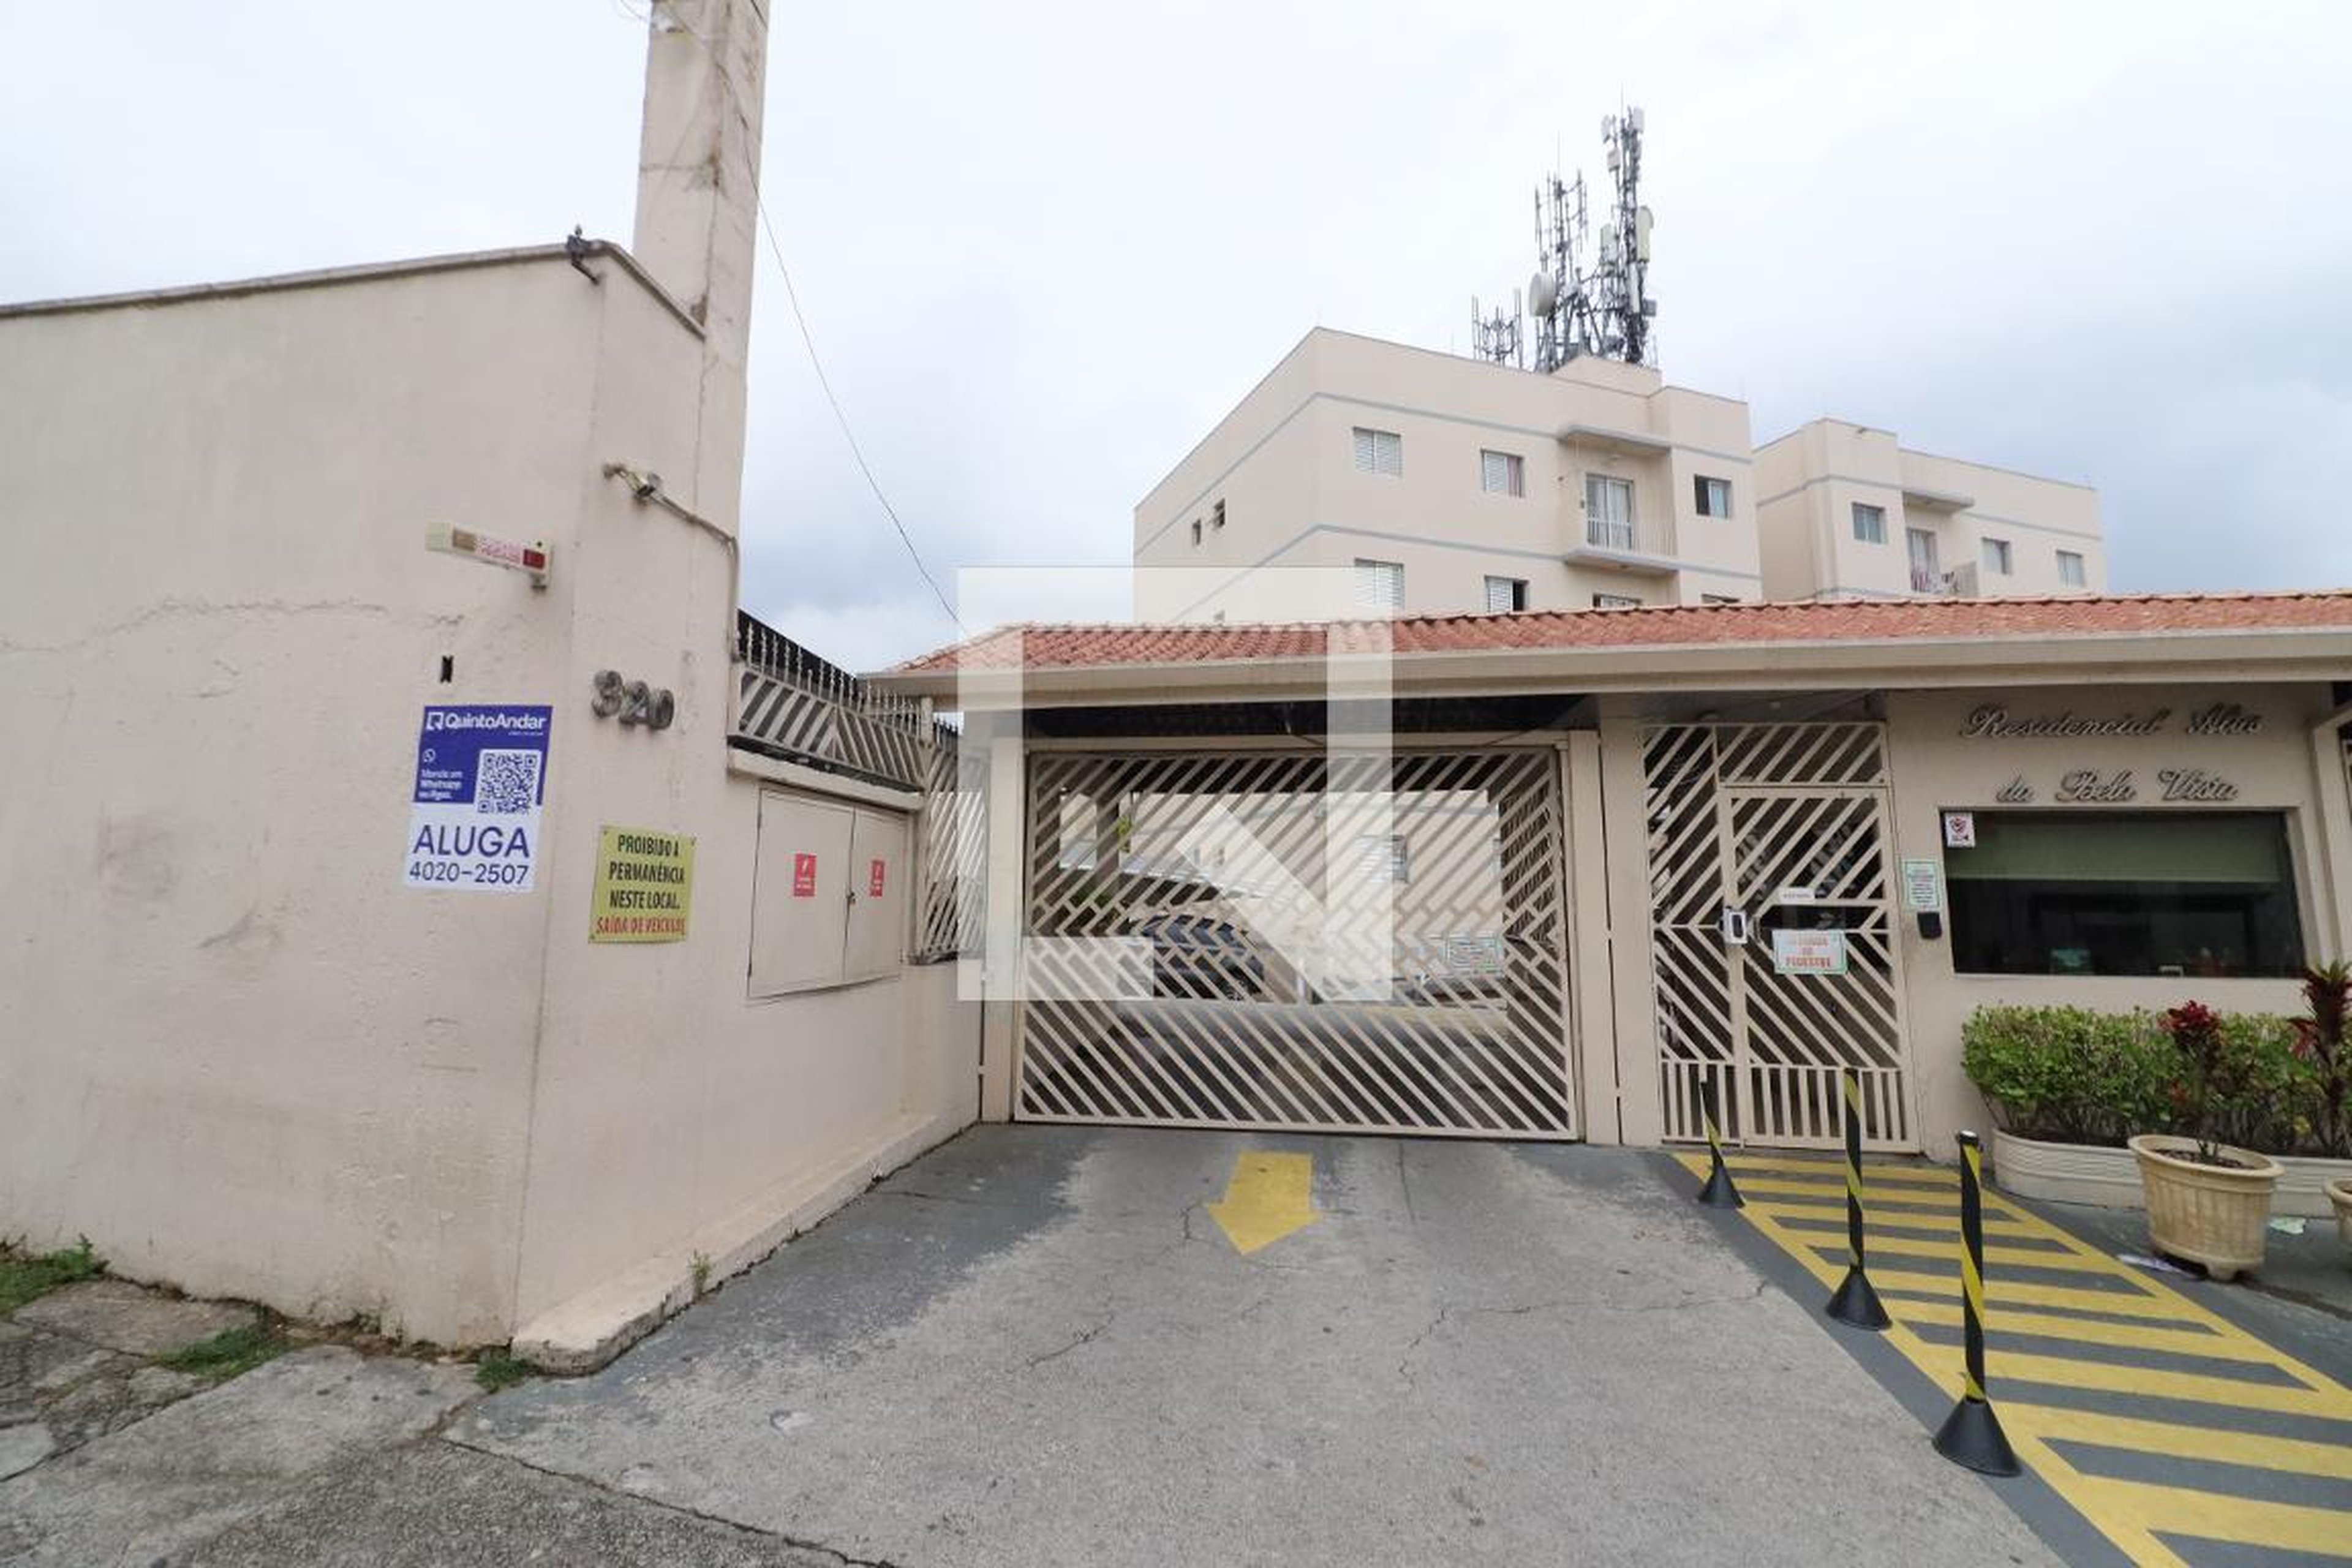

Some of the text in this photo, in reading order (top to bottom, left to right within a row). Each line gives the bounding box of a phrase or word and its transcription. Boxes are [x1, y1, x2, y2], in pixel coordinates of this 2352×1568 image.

[445, 712, 546, 730] QuintoAndar
[1960, 704, 2171, 737] Residencial
[2157, 768, 2239, 801] Vista
[413, 825, 530, 858] ALUGA
[618, 834, 679, 857] PROIBIDO A
[409, 862, 529, 884] 4020-2507
[610, 890, 646, 909] NESTE
